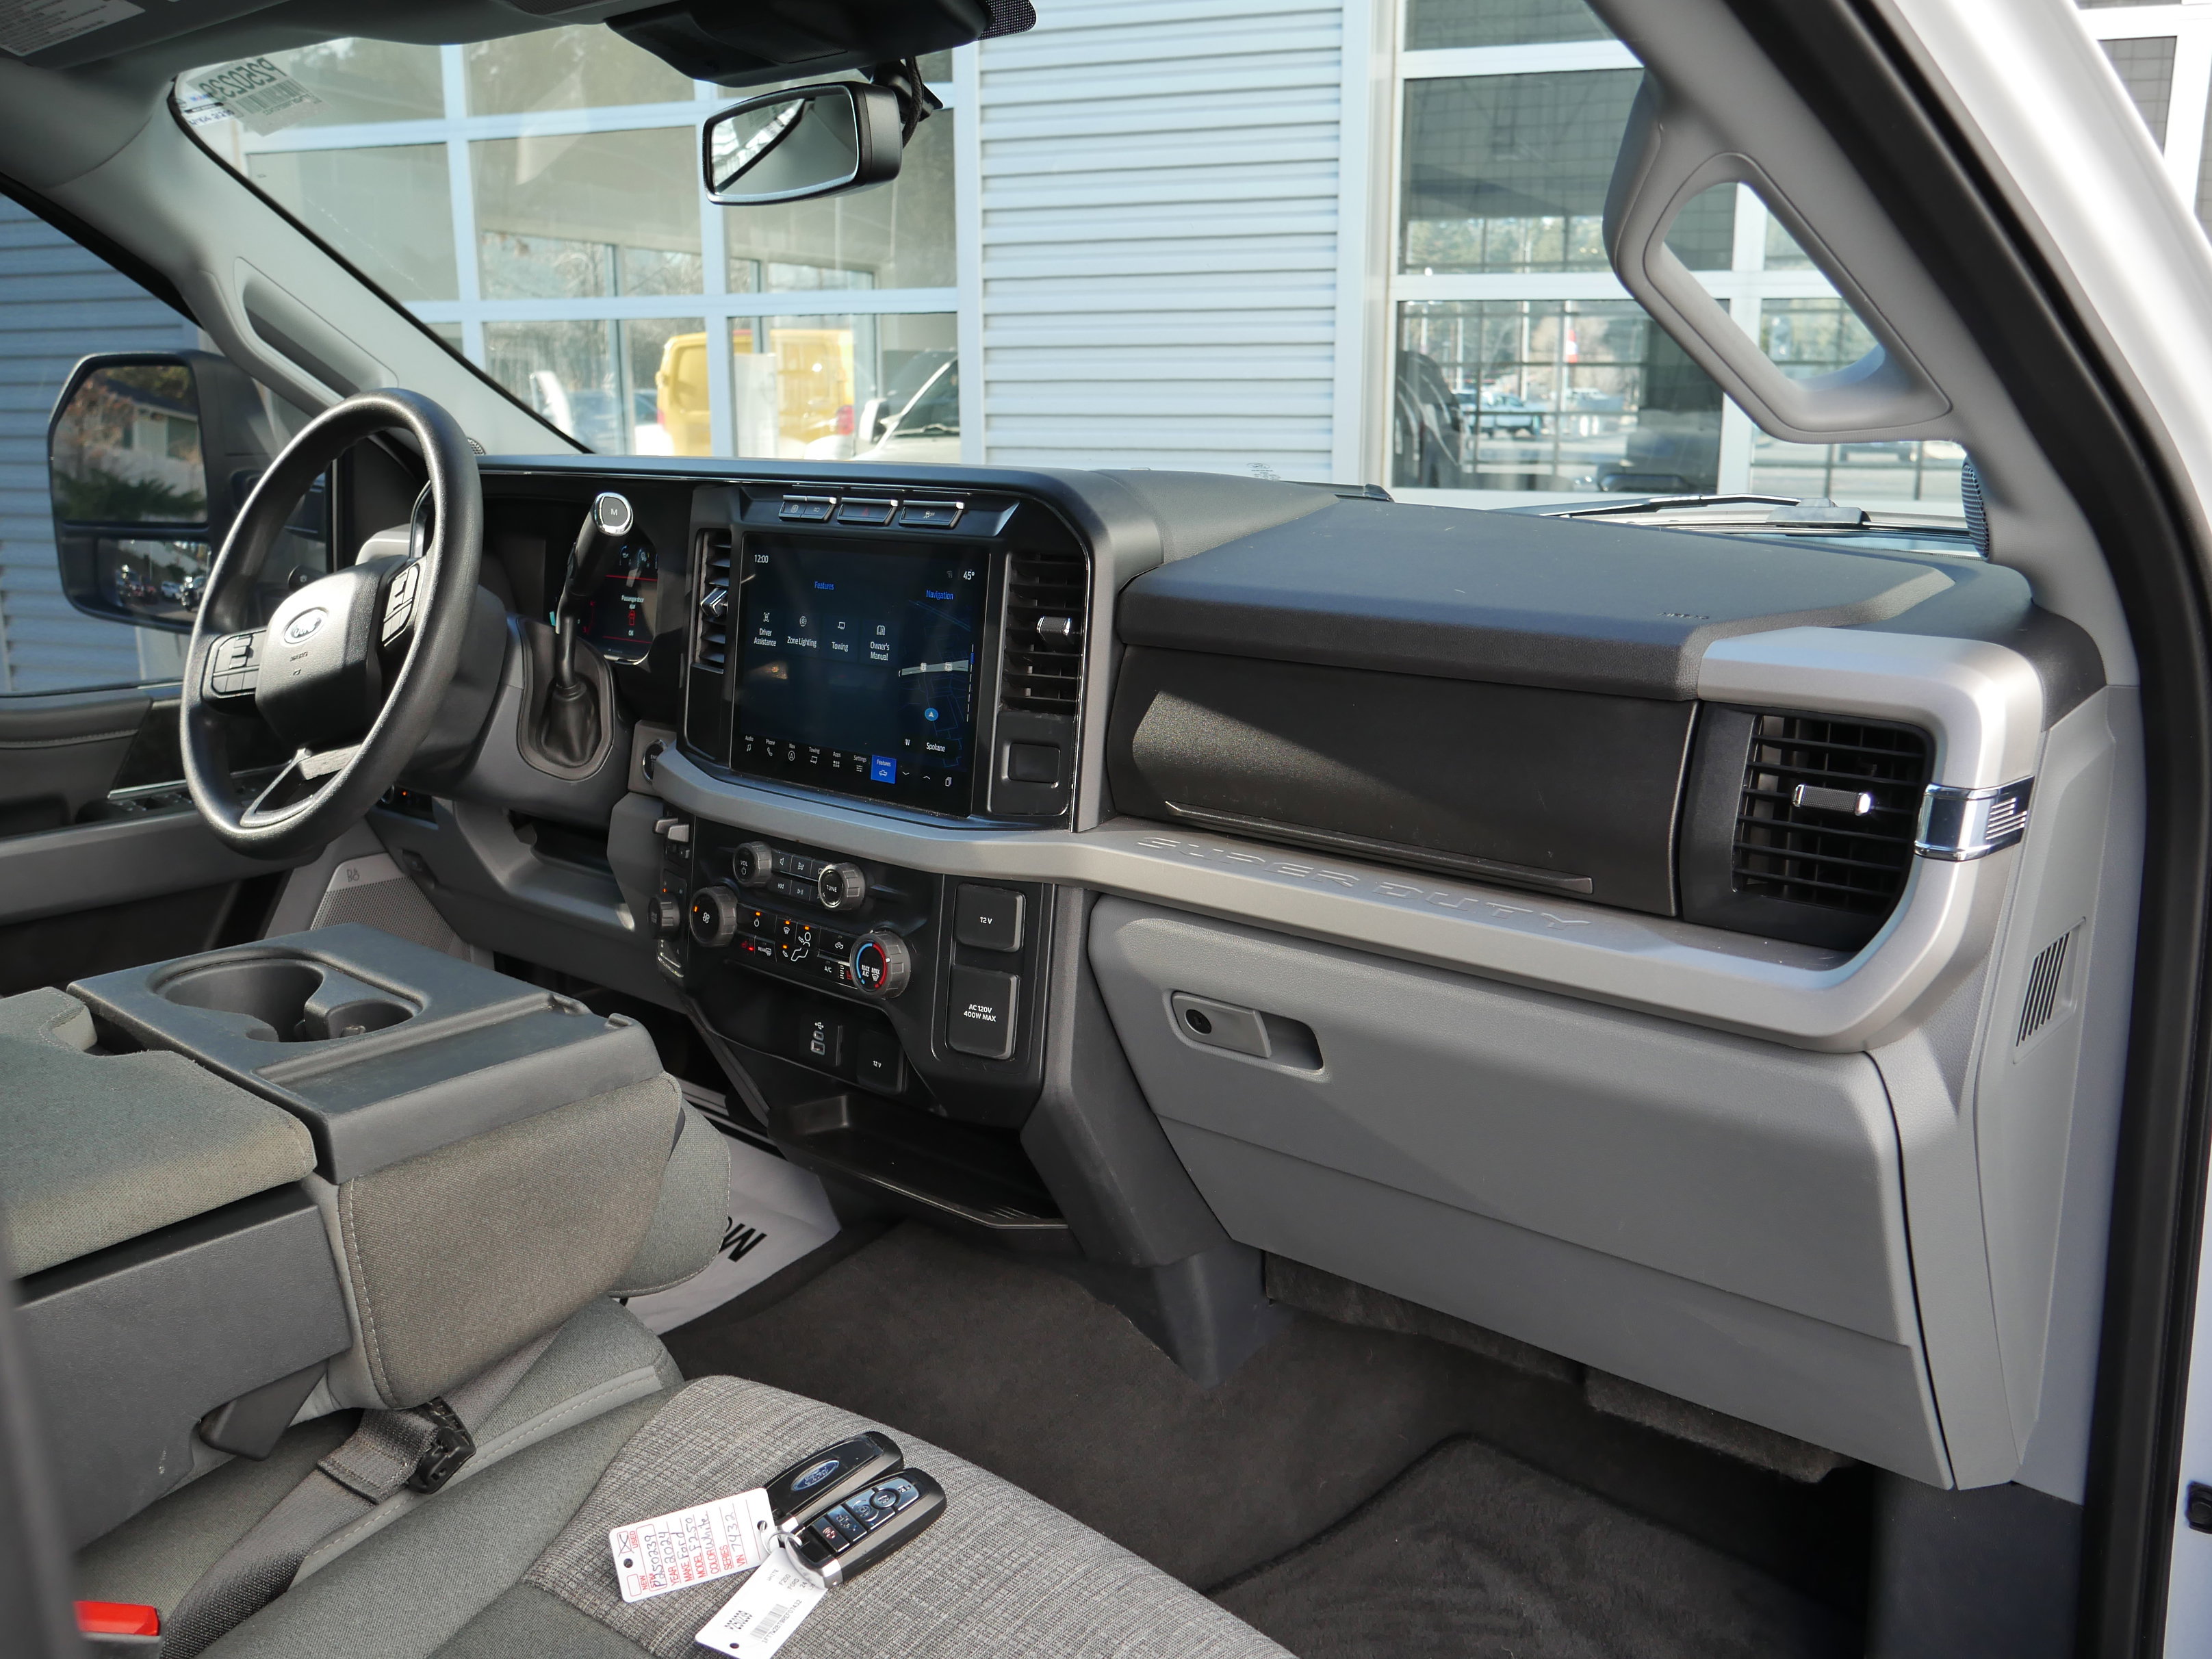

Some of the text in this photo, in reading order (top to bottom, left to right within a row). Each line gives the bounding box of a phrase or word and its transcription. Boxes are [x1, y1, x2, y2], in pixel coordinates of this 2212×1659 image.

[754, 554, 769, 563] 12:00
[814, 581, 834, 590] Features
[926, 589, 953, 600] Navigation
[759, 628, 772, 636] Driver
[754, 636, 777, 647] Assistance
[787, 636, 817, 648] Zone Lighting
[832, 641, 849, 652] Towing
[870, 641, 890, 651] Owner's
[870, 652, 888, 661] Manual
[926, 742, 946, 752] Spokane
[853, 755, 867, 763] Settings
[876, 759, 891, 767] Features
[740, 859, 748, 867] VOL
[826, 884, 837, 893] TUNE
[1134, 836, 1592, 931] SUPER DUTY
[824, 965, 832, 974] A/C
[871, 967, 880, 975] MAX
[968, 1003, 992, 1014] AC 120V
[963, 1010, 996, 1023] 400W MAX
[630, 1530, 639, 1548] USED
[725, 1512, 746, 1567] VIN 7432
[685, 1517, 707, 1578] MODEL F250
[644, 1534, 666, 1587] P250239
[658, 1532, 679, 1586] YEAR 2024
[671, 1532, 693, 1582] MAKE Ford
[706, 1548, 719, 1574] COLOR
[719, 1545, 734, 1571] SERIES
[767, 1569, 779, 1582] WHITE
[778, 1574, 791, 1586] F250
[640, 1575, 648, 1590] NEW
[788, 1578, 800, 1590] FORD
